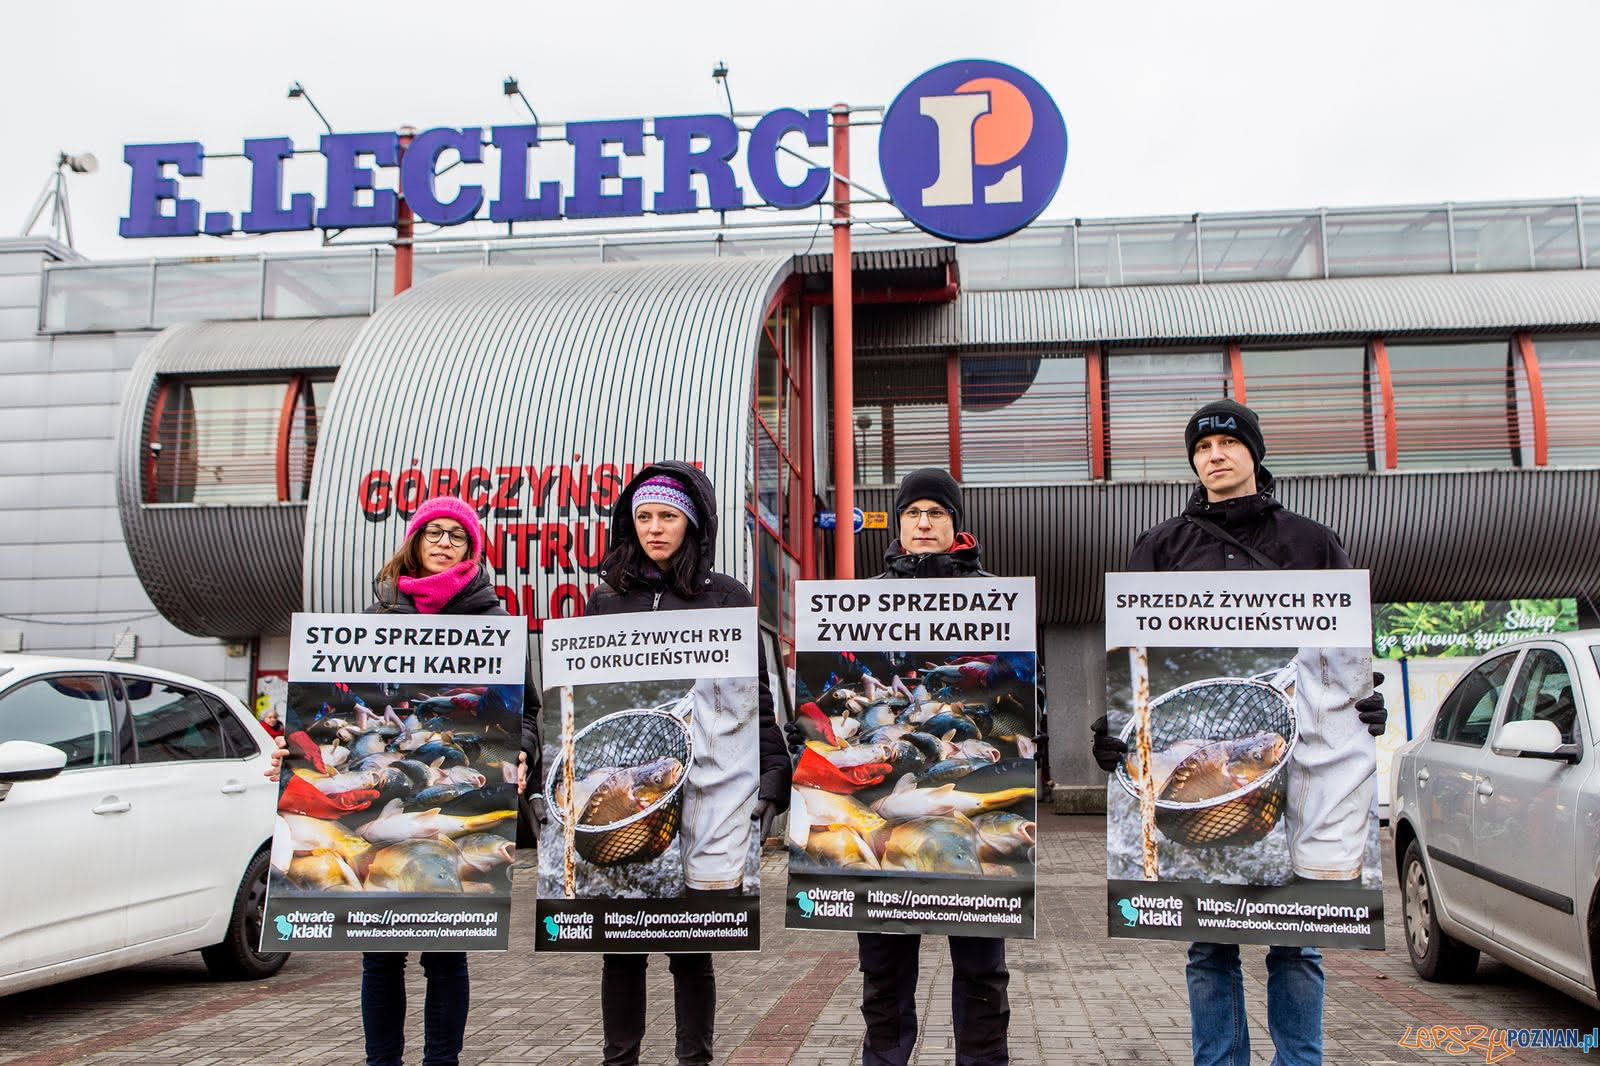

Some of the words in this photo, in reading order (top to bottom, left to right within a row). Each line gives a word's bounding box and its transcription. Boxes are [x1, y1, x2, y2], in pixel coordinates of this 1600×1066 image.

[119, 107, 831, 238] E.LECLERC
[1198, 415, 1237, 432] FILA
[810, 594, 871, 612] STOP
[878, 588, 1018, 612] SPRZEDAŻY
[1116, 590, 1214, 608] SPRZEDAŻ
[1219, 590, 1305, 608] ŻYWYCH
[1312, 593, 1352, 608] RYB
[817, 618, 921, 641] ŻYWYCH
[929, 622, 1010, 641] KARPI!
[1136, 615, 1162, 631] TO
[1168, 612, 1337, 631] OKRUCIEŃSTWO!
[1504, 610, 1556, 632] Sklep
[306, 626, 368, 645] STOP
[374, 625, 511, 647] SPRZEDAŻY
[551, 631, 627, 652] SPRZEDAŻ
[631, 629, 703, 646] ŻYWYCH
[708, 628, 742, 643] RYB
[311, 650, 415, 674] ŻYWYCH
[424, 655, 502, 675] KARPI!
[566, 656, 586, 671] TO
[590, 648, 729, 669] OKRUCIEŃSTWO!
[808, 887, 855, 902] otwarte
[867, 889, 1022, 911] https://pomozkarpiom.pl
[1131, 894, 1184, 910] otwarte
[287, 910, 335, 924] otwarte
[553, 911, 594, 924] otwarte
[814, 901, 853, 918] klatki
[867, 908, 1022, 924] www.facebook.com/otwarteklatki
[1139, 908, 1182, 927] klatki
[1197, 898, 1369, 919] https://pomozkarpiom.pl
[347, 910, 498, 926] https://pomozkarpiom.pl
[604, 911, 748, 927] https://pomozkarpiom.pl
[1197, 917, 1371, 935] www.facebook.com/otwarteklatki
[292, 924, 333, 939] klatki
[346, 927, 498, 938] www.facebook.com/otwarteklatki
[559, 925, 593, 940] klatki
[604, 927, 749, 939] www.facebook.com/otwarteklatki
